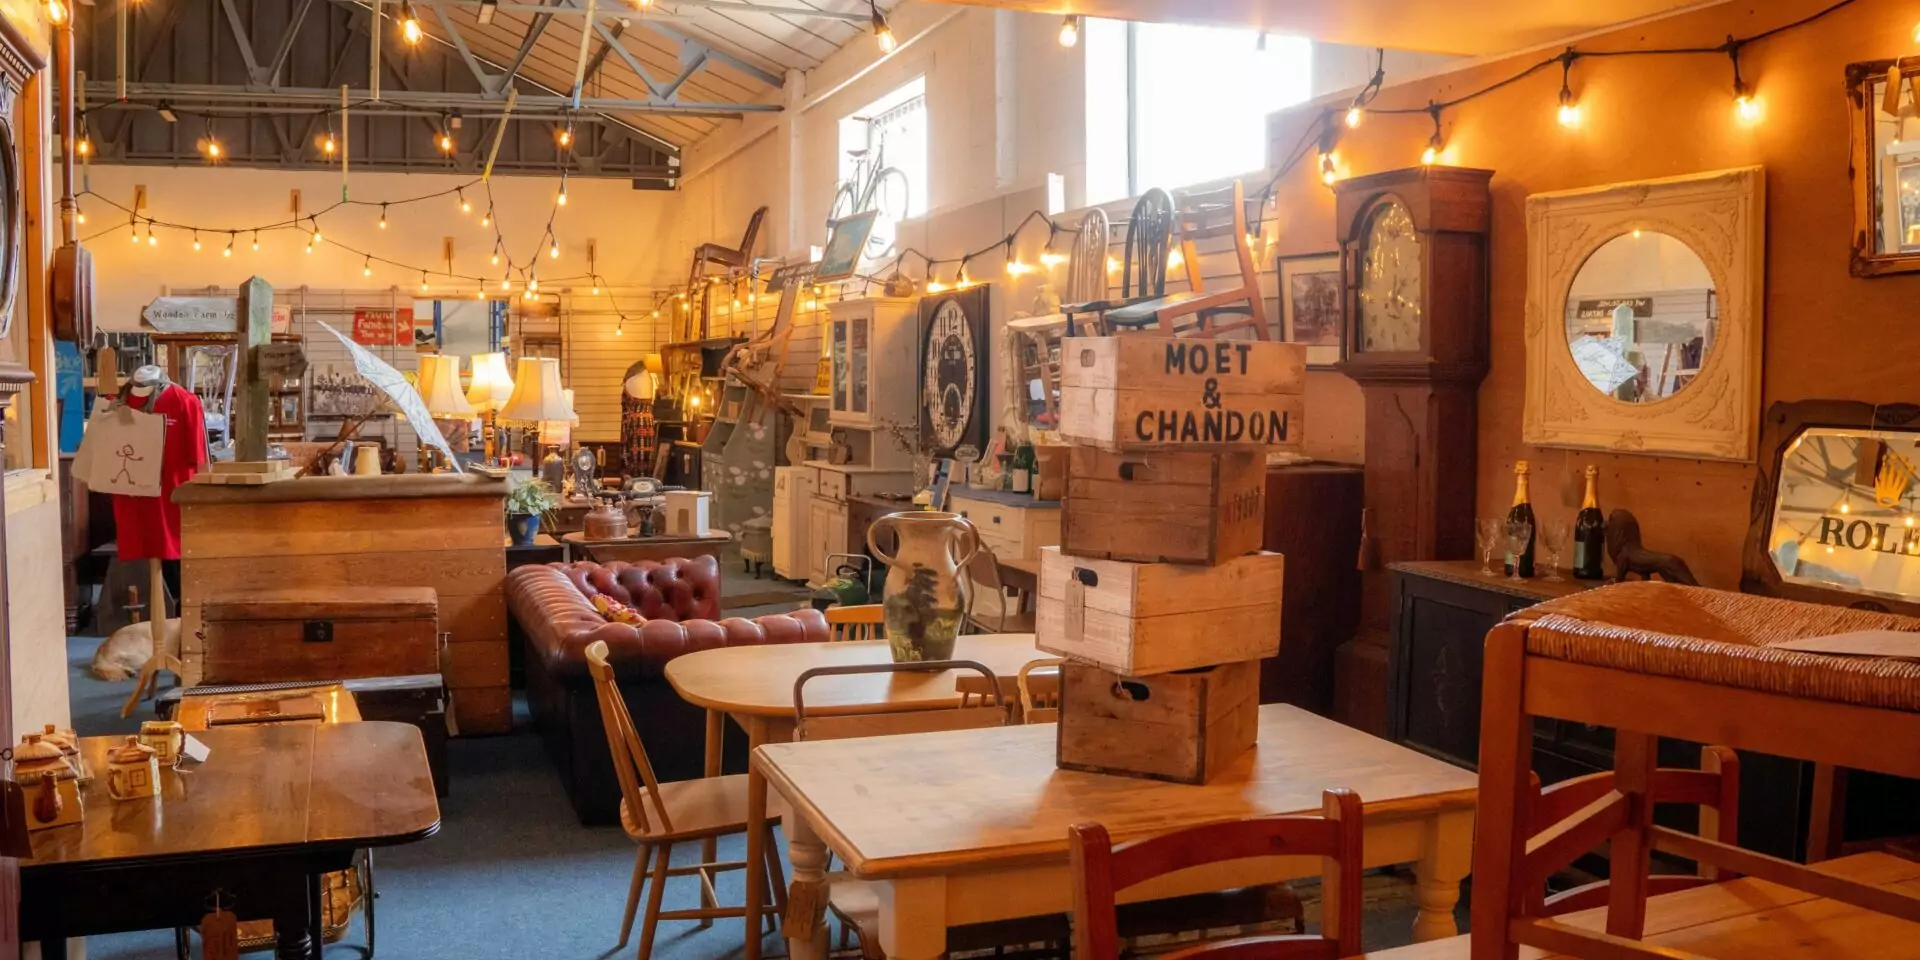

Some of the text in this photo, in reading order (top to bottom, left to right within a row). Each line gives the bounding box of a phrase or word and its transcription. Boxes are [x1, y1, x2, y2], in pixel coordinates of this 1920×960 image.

[1165, 342, 1252, 375] MOET
[1202, 377, 1222, 409] &
[1135, 410, 1289, 443] CHANDON
